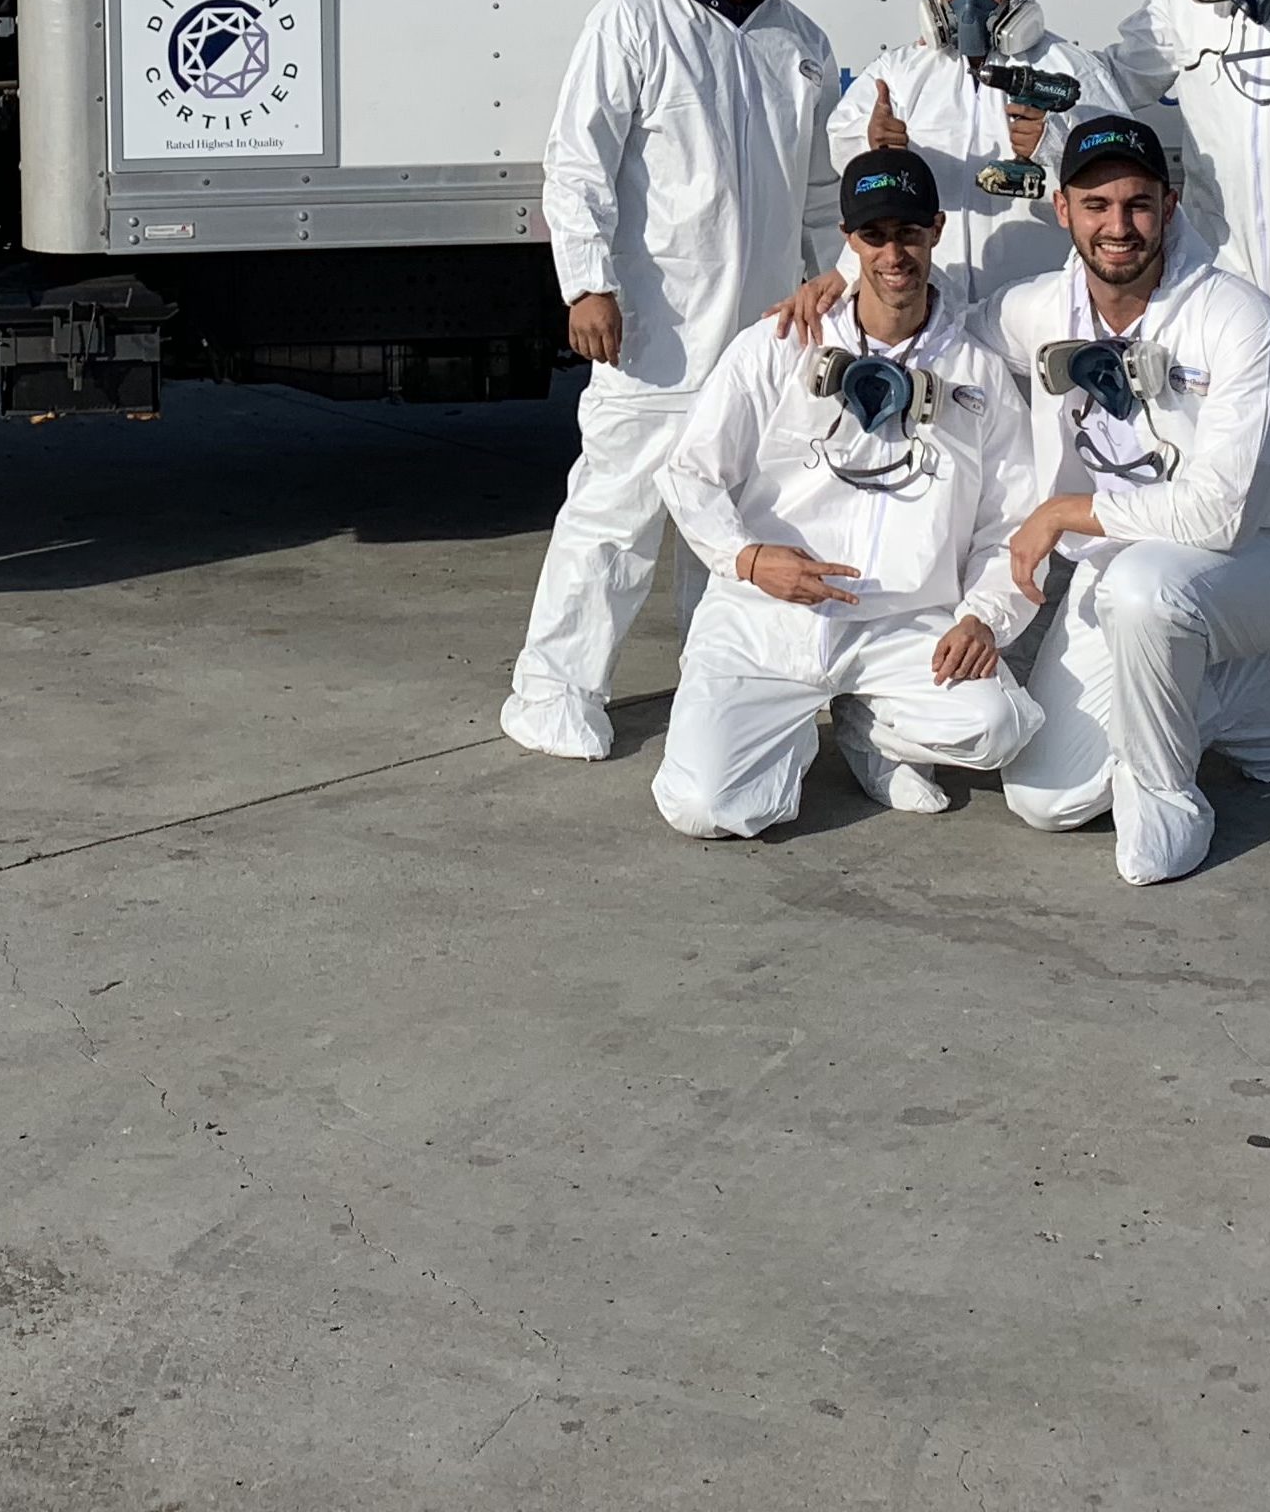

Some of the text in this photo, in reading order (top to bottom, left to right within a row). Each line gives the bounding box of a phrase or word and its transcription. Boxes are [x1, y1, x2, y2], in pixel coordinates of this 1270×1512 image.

[145, 63, 298, 130] CERTIFIED
[166, 137, 285, 151] Rated Highest In Quality
